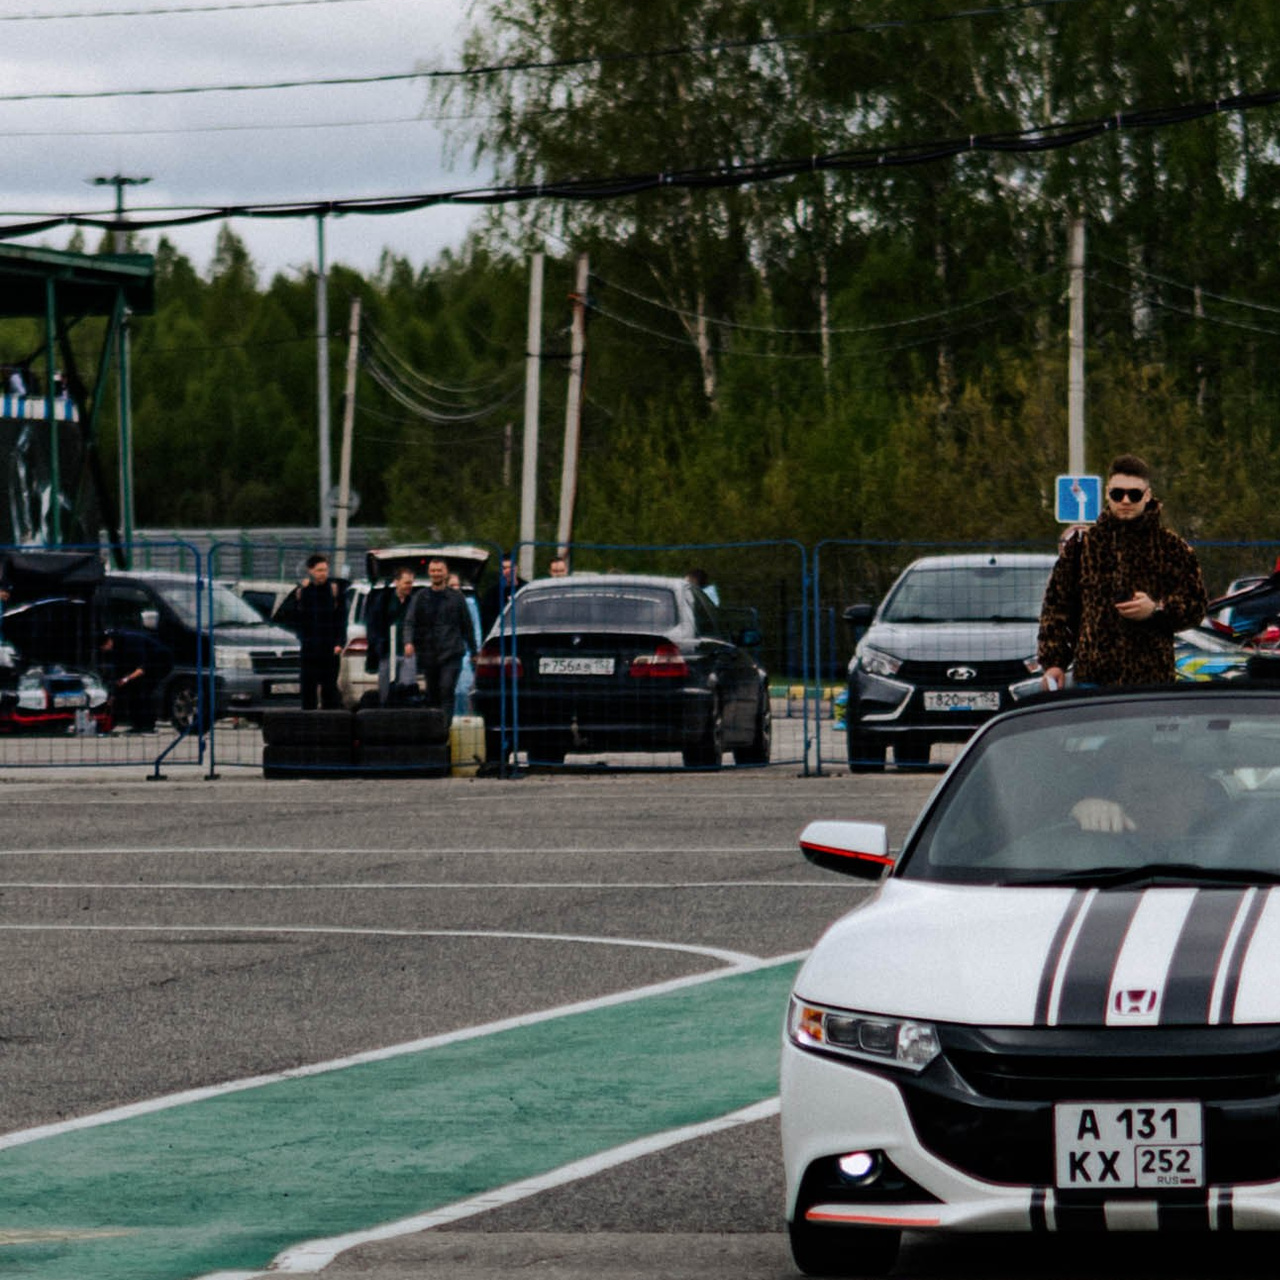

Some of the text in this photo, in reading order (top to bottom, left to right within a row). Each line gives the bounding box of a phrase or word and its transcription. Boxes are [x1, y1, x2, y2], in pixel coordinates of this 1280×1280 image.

[1115, 1108, 1178, 1140] 131
[1141, 1149, 1191, 1174] 252
[1157, 1175, 1180, 1185] RUS
